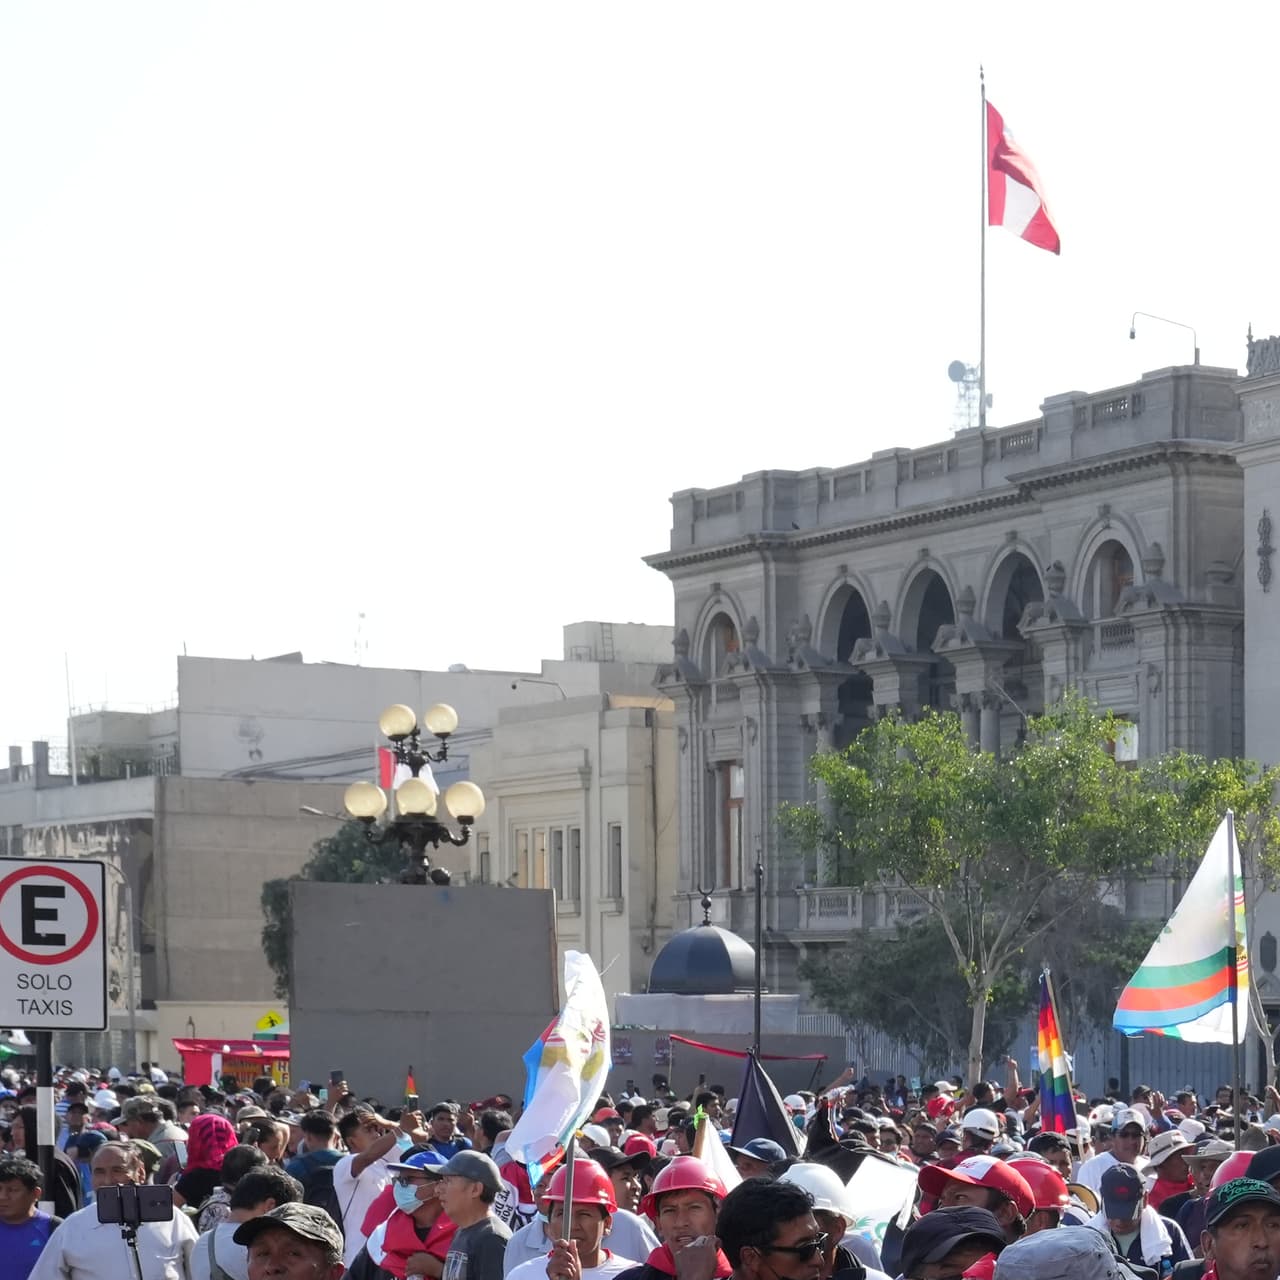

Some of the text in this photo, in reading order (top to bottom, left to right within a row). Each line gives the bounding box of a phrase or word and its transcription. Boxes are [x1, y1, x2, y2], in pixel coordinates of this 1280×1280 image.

[21, 885, 66, 946] E
[17, 973, 72, 991] SOLO
[17, 999, 73, 1016] TAXIS
